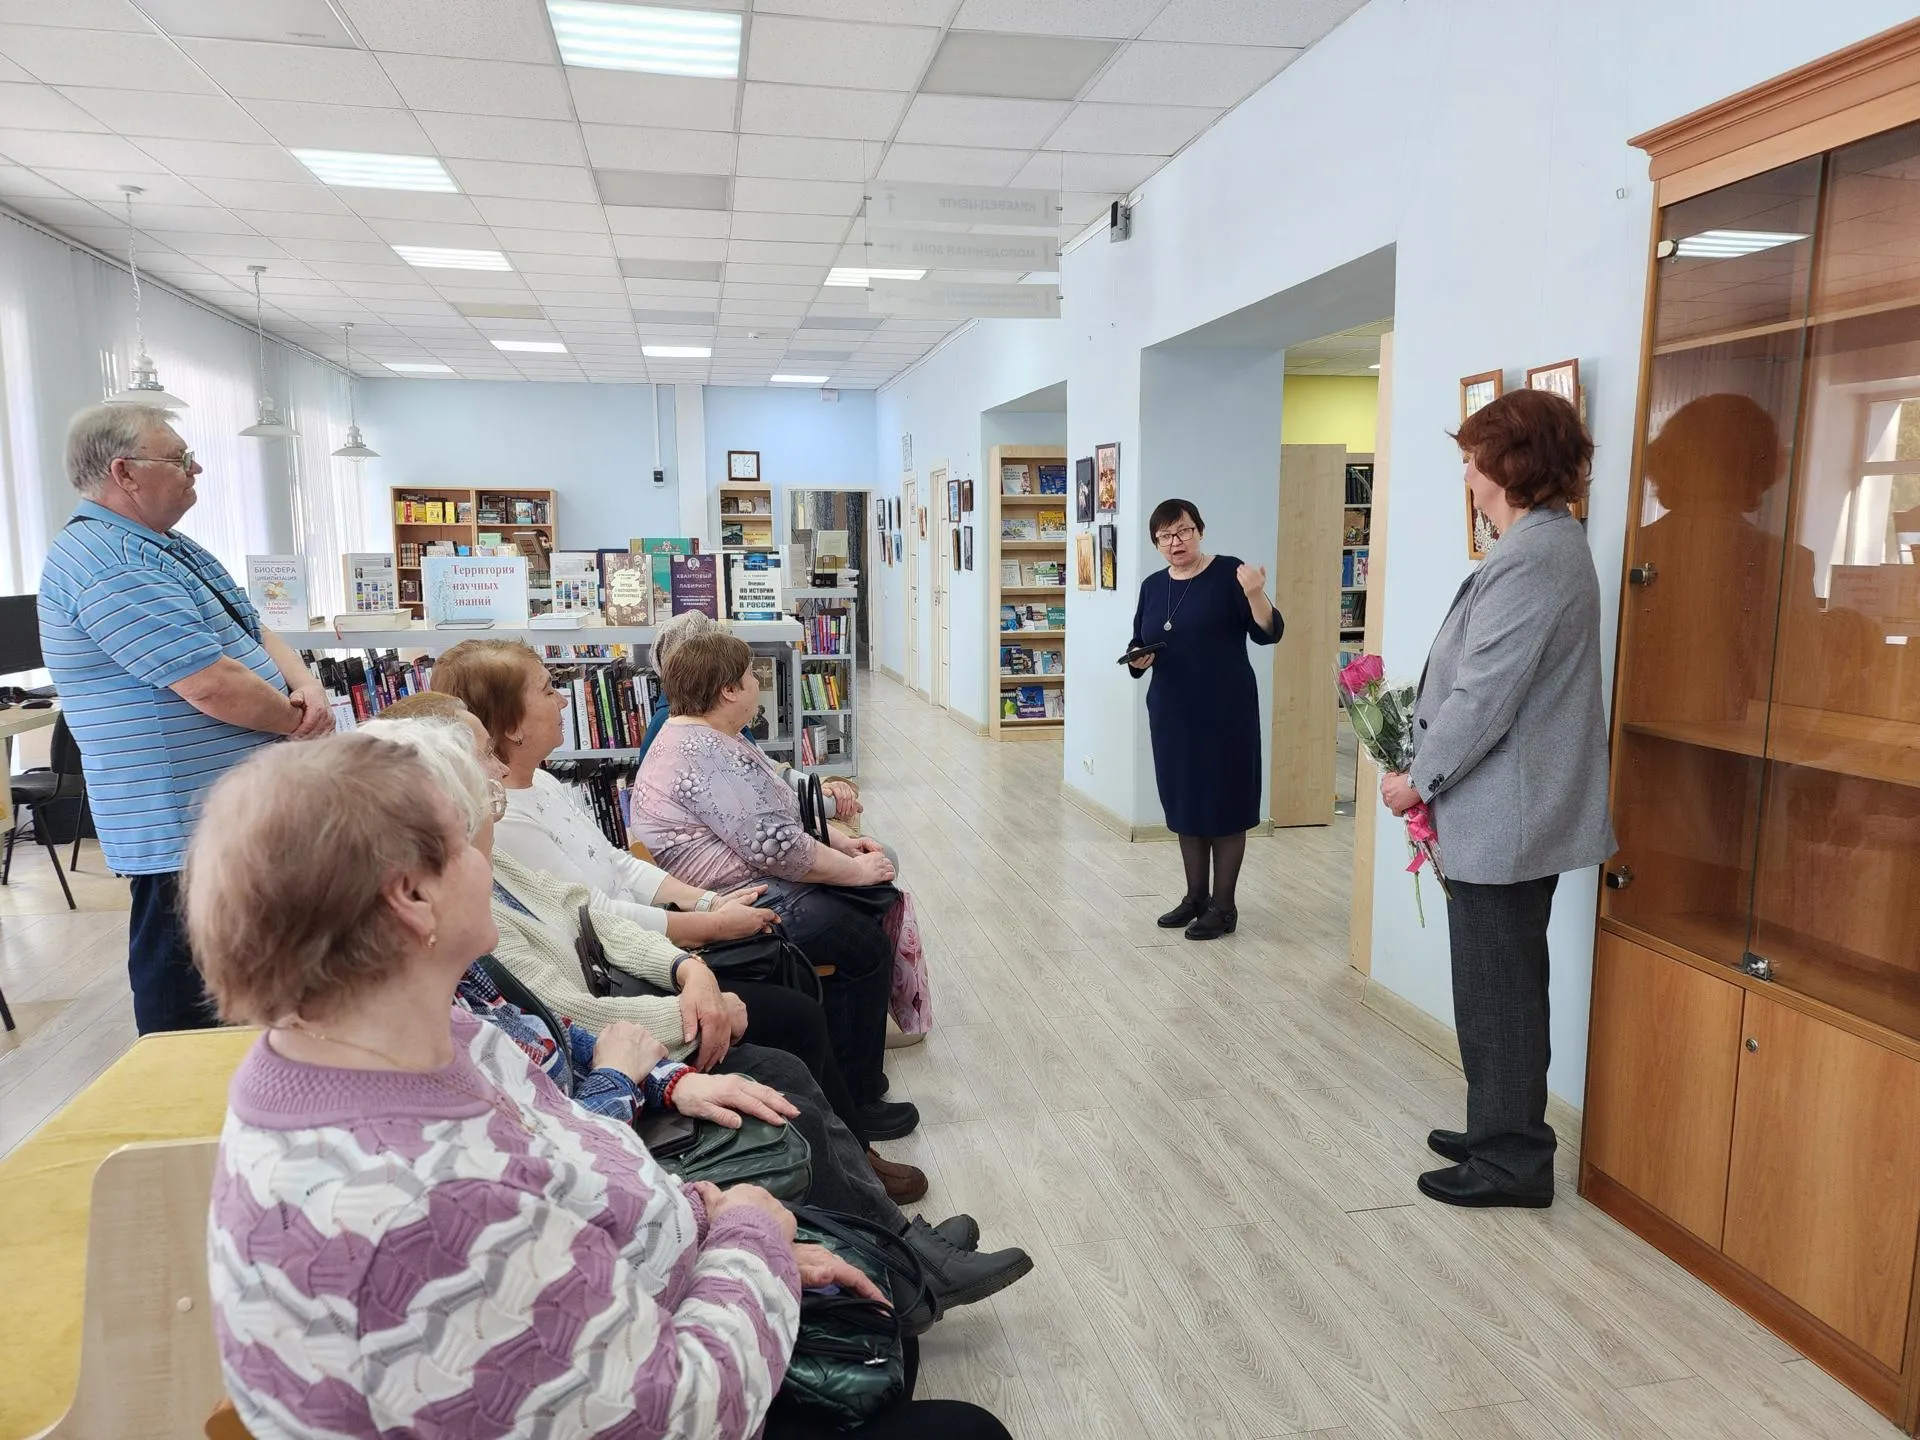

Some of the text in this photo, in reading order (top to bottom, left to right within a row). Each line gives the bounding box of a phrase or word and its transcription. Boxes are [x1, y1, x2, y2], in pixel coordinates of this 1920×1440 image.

[451, 564, 516, 576] Территория
[452, 581, 499, 592] научных
[453, 595, 491, 606] знаний
